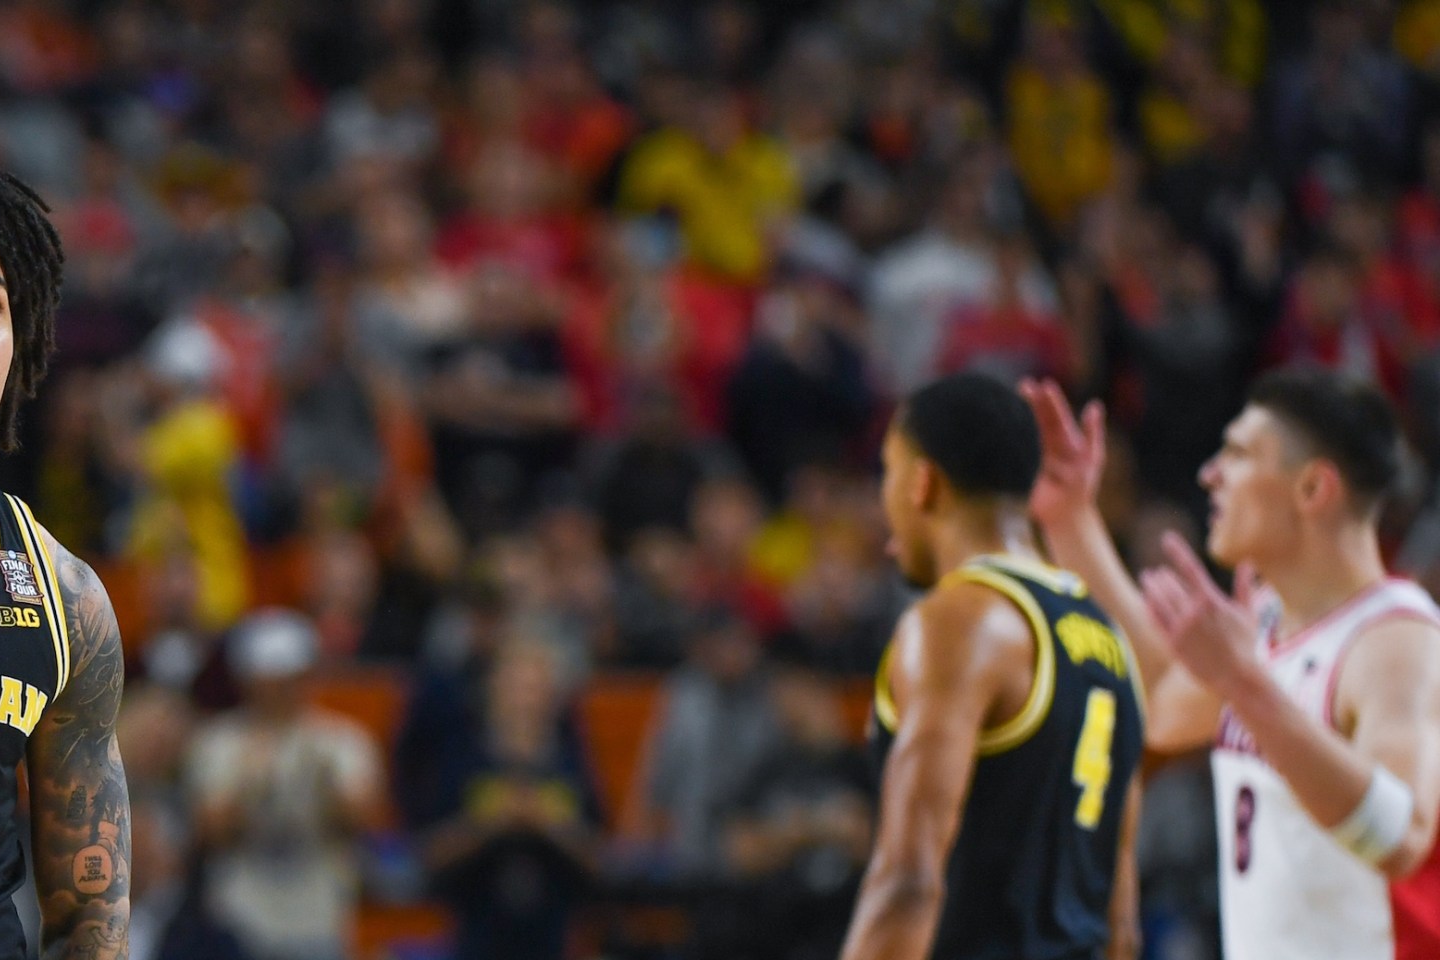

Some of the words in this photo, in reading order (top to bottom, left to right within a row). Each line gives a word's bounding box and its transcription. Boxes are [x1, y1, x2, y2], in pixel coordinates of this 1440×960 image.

[1, 560, 29, 573] FINAL
[10, 582, 37, 595] FOUR
[1072, 687, 1117, 830] 4
